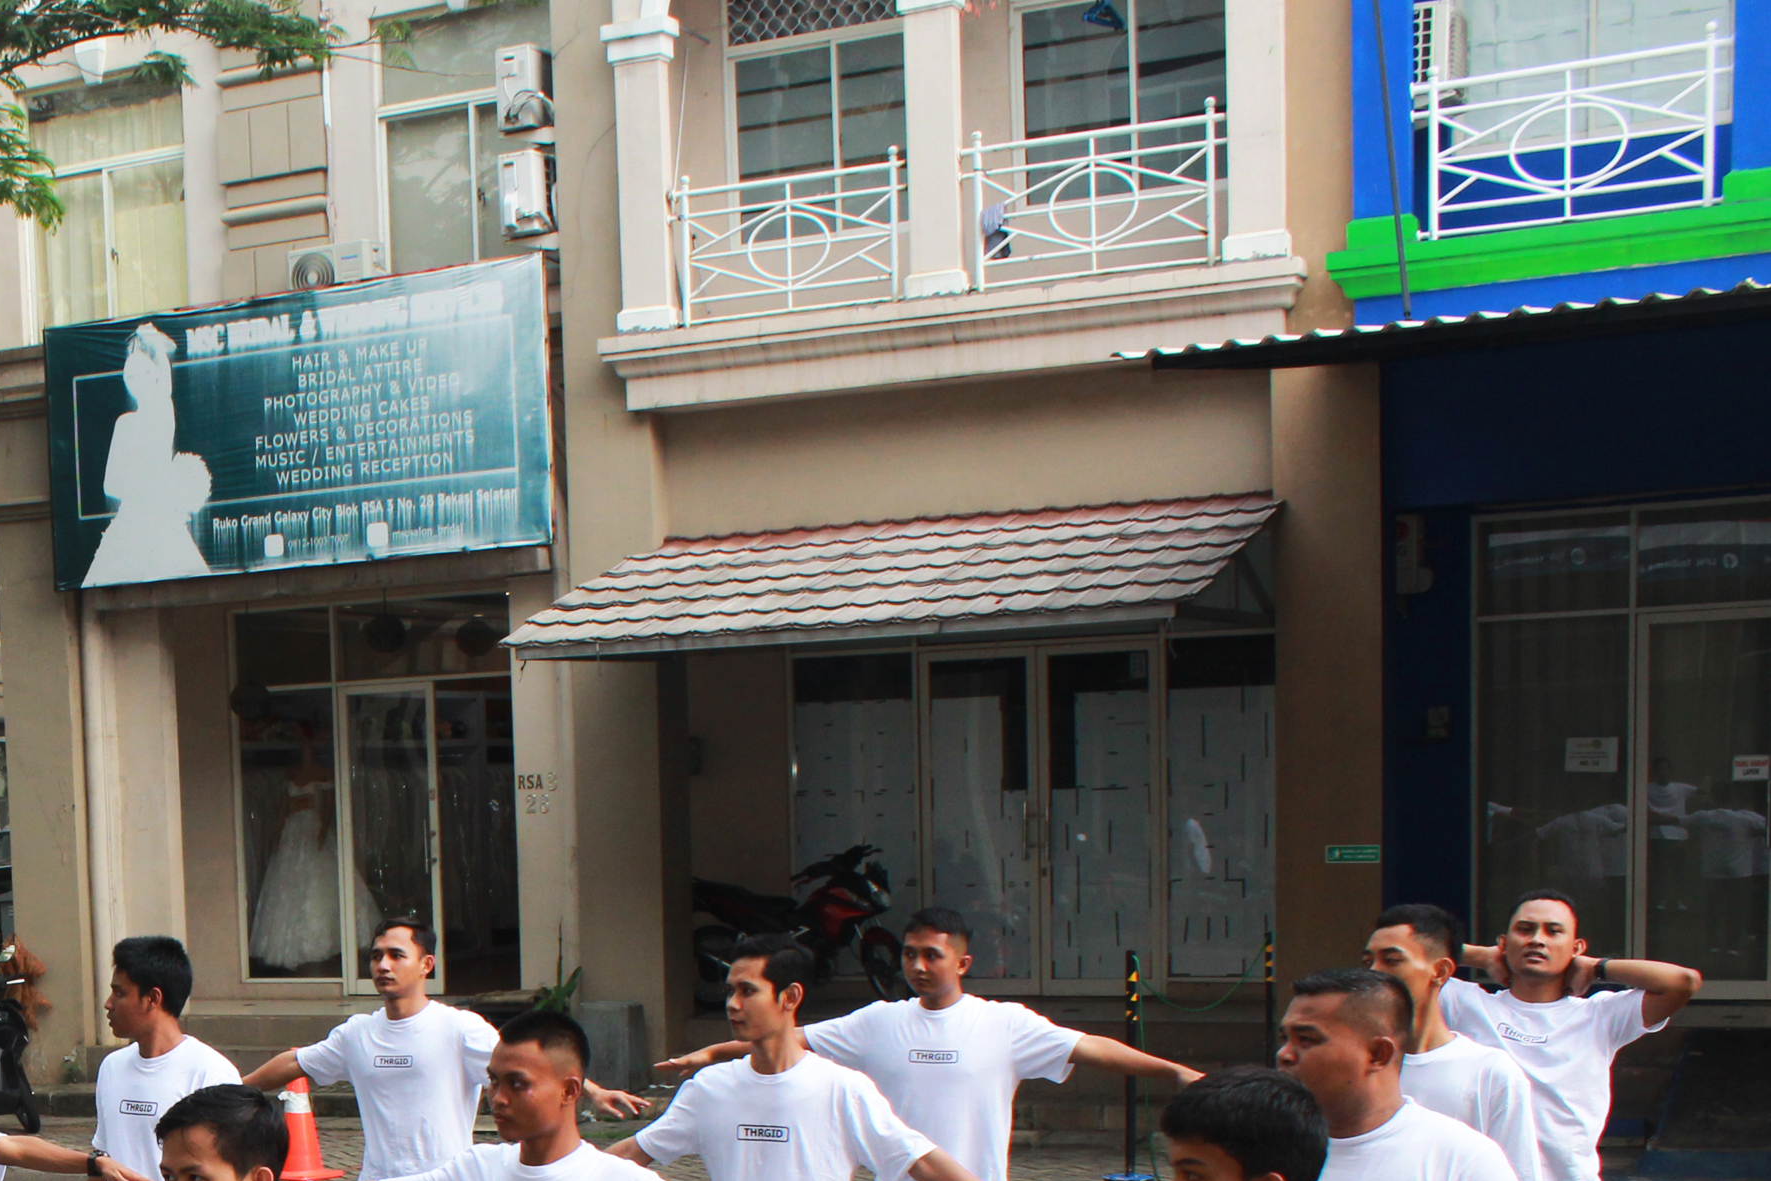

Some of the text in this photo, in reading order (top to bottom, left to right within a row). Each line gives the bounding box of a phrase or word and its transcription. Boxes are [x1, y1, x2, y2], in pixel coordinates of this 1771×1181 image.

[292, 338, 427, 370] HAIR & MAKE UP
[298, 358, 423, 388] BRIDAL ATTIRE
[264, 372, 460, 412] PHOTOGRAPHY & VIDEO
[294, 396, 430, 427] WEDDING CAKES
[255, 410, 473, 450] FLOWERS & DECORATIONS
[255, 429, 475, 469] MUSIC / ENTERTAINMENTS
[276, 452, 454, 485] WEDDING RECEPTION
[213, 517, 238, 530] Ruko
[240, 512, 271, 526] Grand
[274, 509, 309, 524] Galaxy
[312, 505, 332, 519] City
[335, 503, 359, 517] Blok
[362, 500, 383, 514] RSA
[387, 498, 394, 511] 3
[420, 494, 434, 508] 28
[438, 490, 473, 507] Bekasi
[476, 487, 518, 502] Selatan
[518, 774, 543, 790] RSA
[381, 1057, 409, 1066] THRGID
[915, 1051, 953, 1061] THRGID
[125, 1102, 153, 1112] THRGID
[743, 1127, 783, 1139] THRGID
